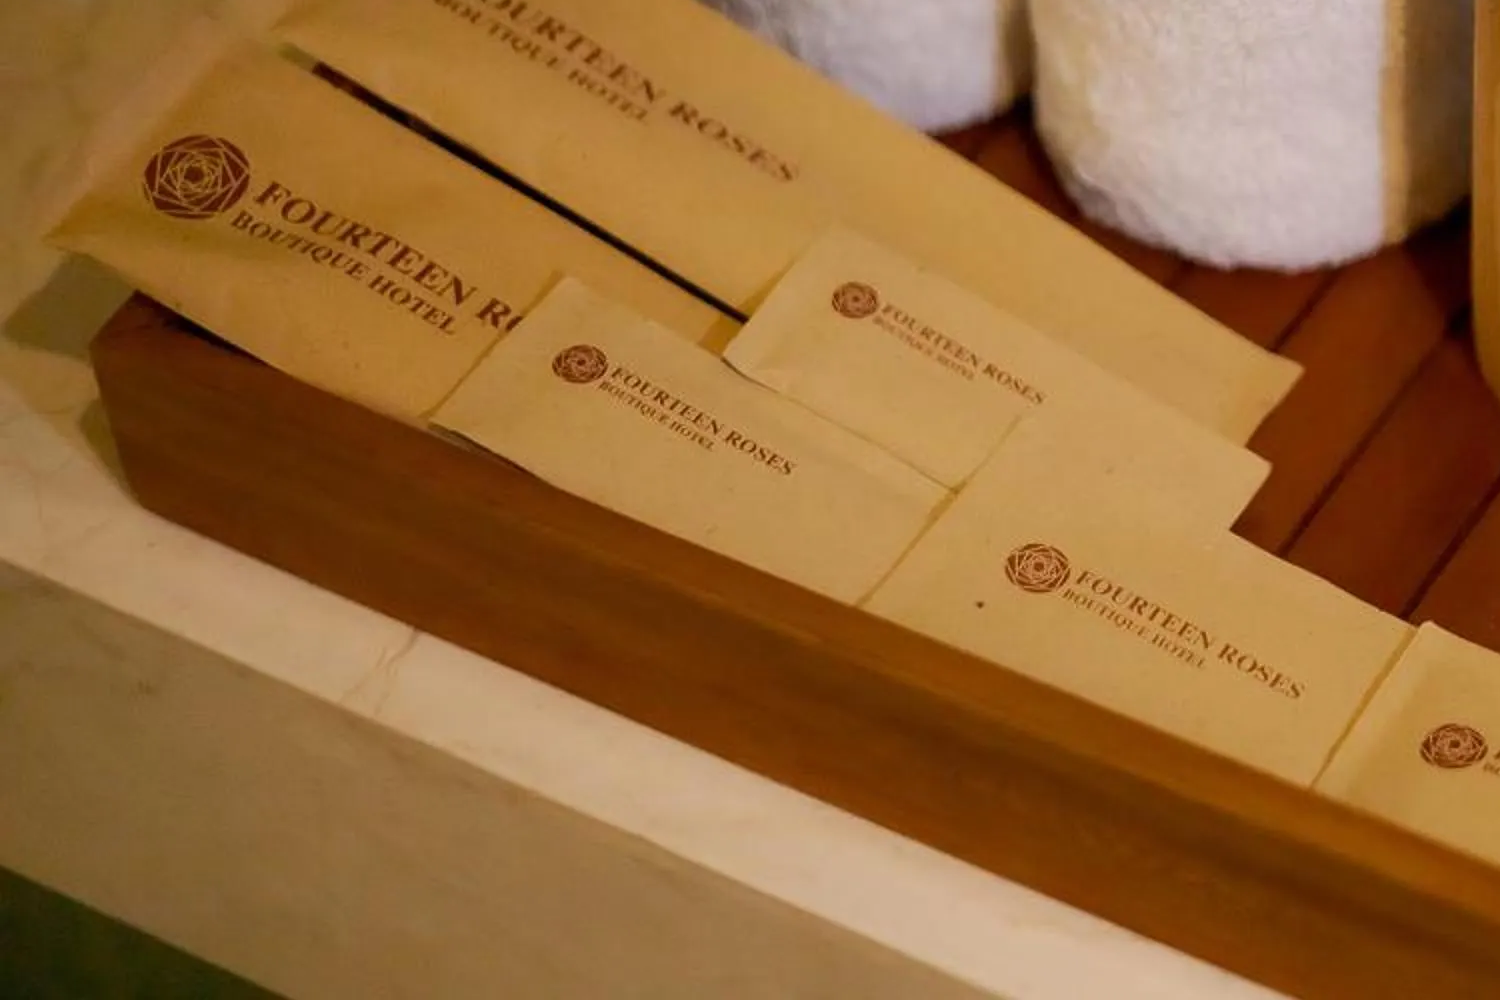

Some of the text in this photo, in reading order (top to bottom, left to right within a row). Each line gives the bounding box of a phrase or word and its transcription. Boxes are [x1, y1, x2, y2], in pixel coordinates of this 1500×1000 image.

[669, 101, 798, 183] ROSES
[230, 209, 457, 336] BOUTIQUE HOTEL
[255, 180, 478, 307] FOURTEEN
[881, 303, 985, 369] FOURTEEN
[983, 362, 1046, 405] ROSES
[598, 380, 715, 452] BOUTIQUE HOTEL
[610, 367, 797, 476] FOURTEEN ROSES
[1062, 587, 1206, 670] BOUTIQUE HOTEL
[1075, 569, 1306, 699] FOURTEEN ROSES
